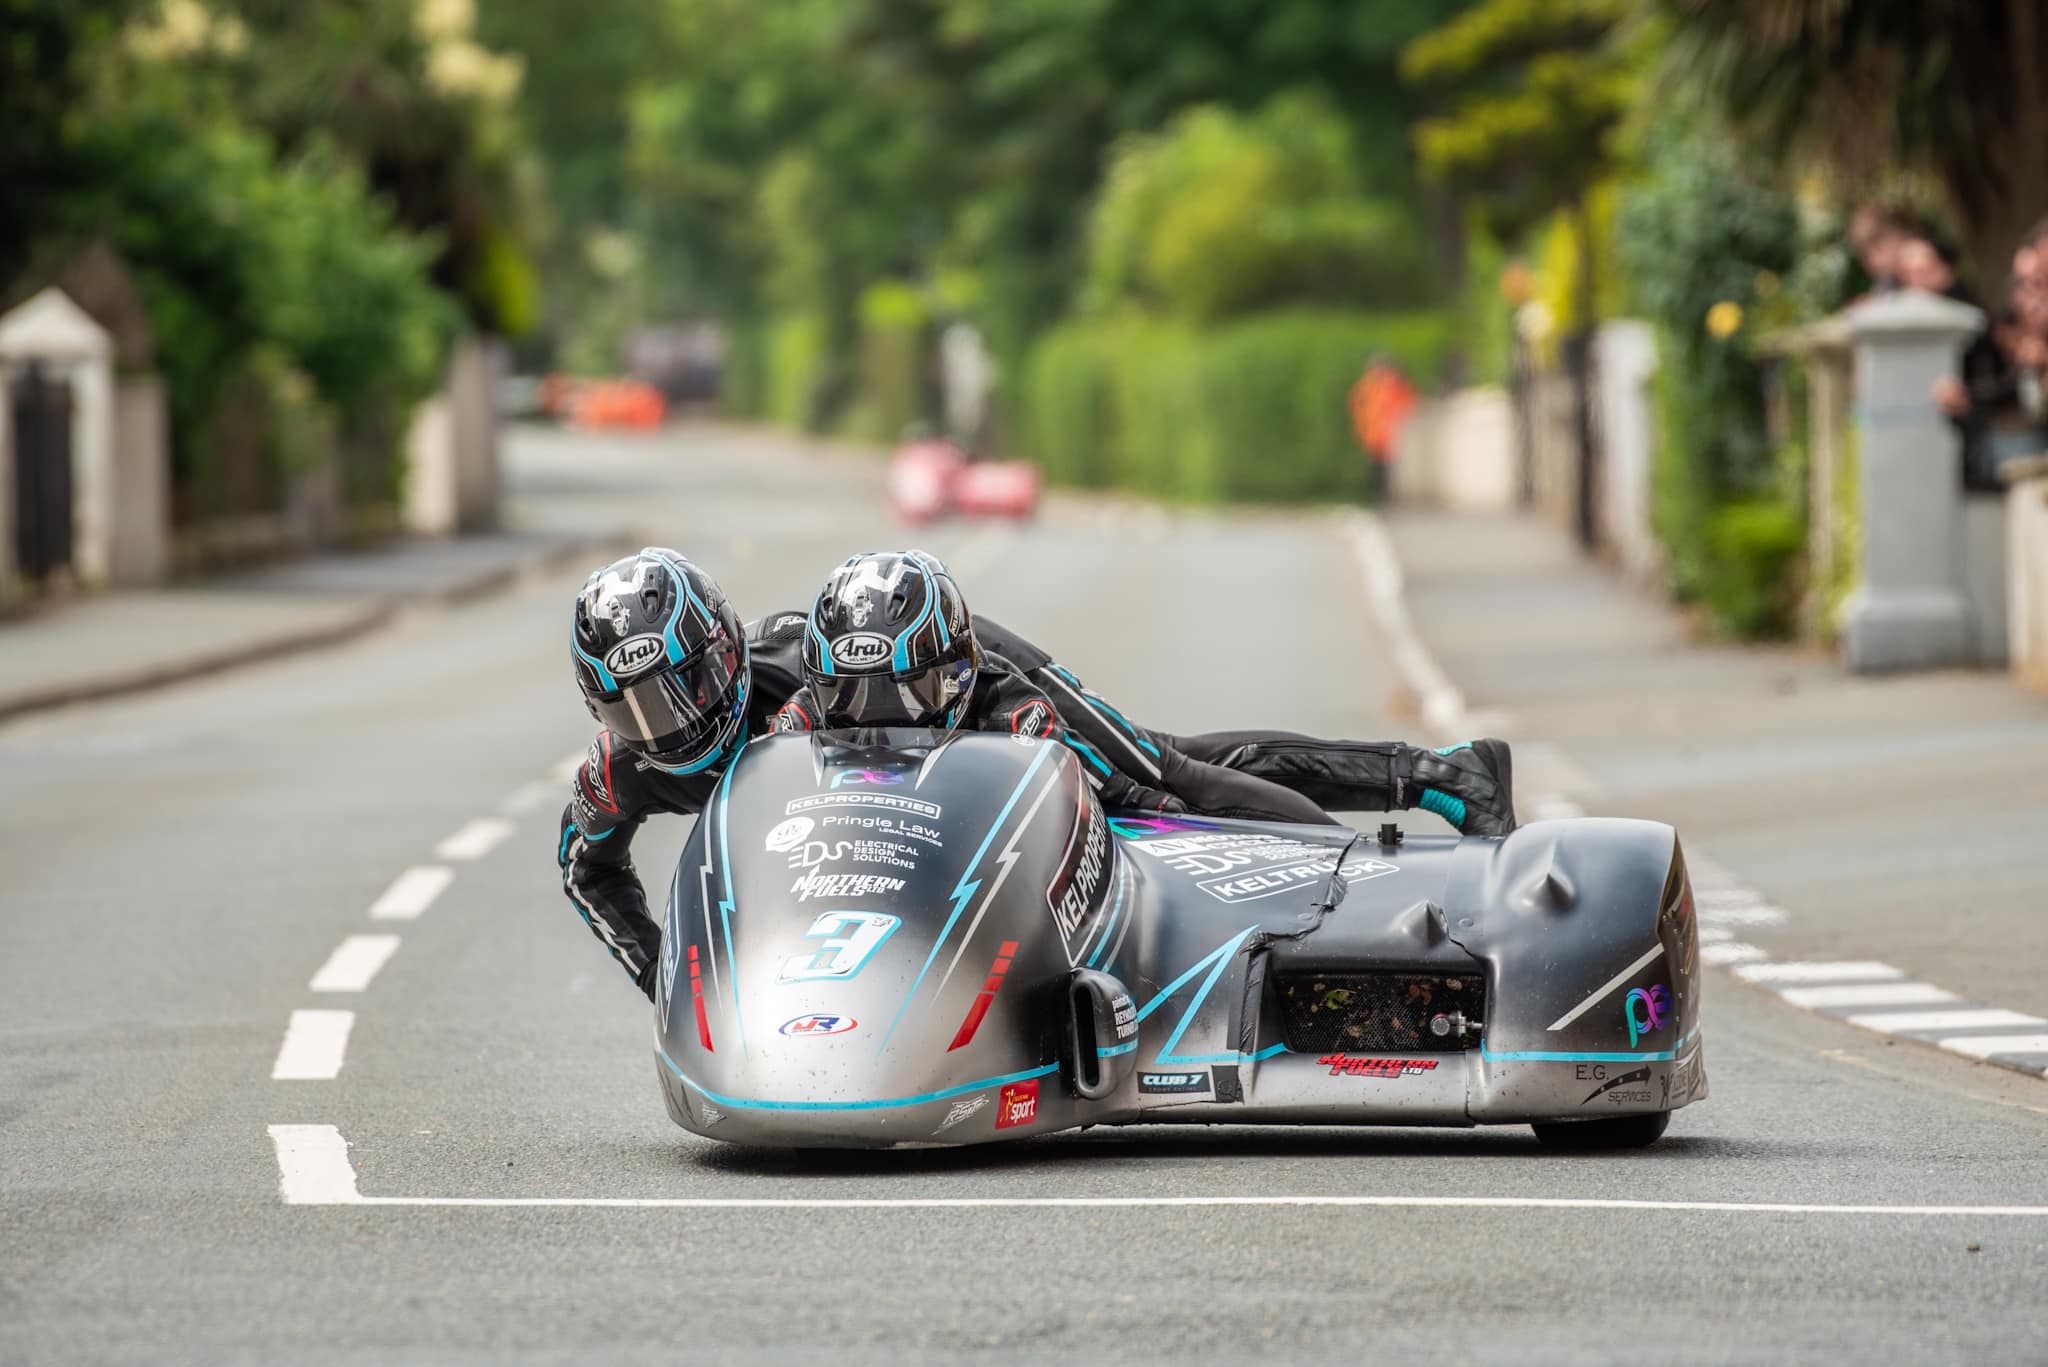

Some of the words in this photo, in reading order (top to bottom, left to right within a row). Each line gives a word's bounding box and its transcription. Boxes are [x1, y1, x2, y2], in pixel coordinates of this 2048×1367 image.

[611, 638, 657, 672] Arai
[834, 638, 886, 657] Arai
[791, 795, 936, 815] KELPROPERTIES
[822, 816, 893, 828] Pringle
[899, 820, 941, 839] Law
[879, 827, 905, 836] LEGAL
[905, 832, 944, 848] SERVICES
[853, 847, 895, 858] DESIGN
[854, 840, 919, 857] ELECTRICAL
[852, 854, 916, 870] SOLUTIONS
[790, 864, 907, 893] NORTHERN
[1213, 860, 1387, 898] KELTRUCK
[798, 884, 866, 902] FUELS
[866, 884, 886, 893] LTD
[776, 910, 902, 984] 3
[792, 1017, 840, 1030] JR
[1143, 1074, 1188, 1086] CLUB
[1188, 1074, 1203, 1085] 7
[1401, 1067, 1424, 1075] LTD
[1575, 1065, 1610, 1080] E.G.
[1607, 1091, 1651, 1104] SERVICES
[1010, 1096, 1035, 1124] sport
